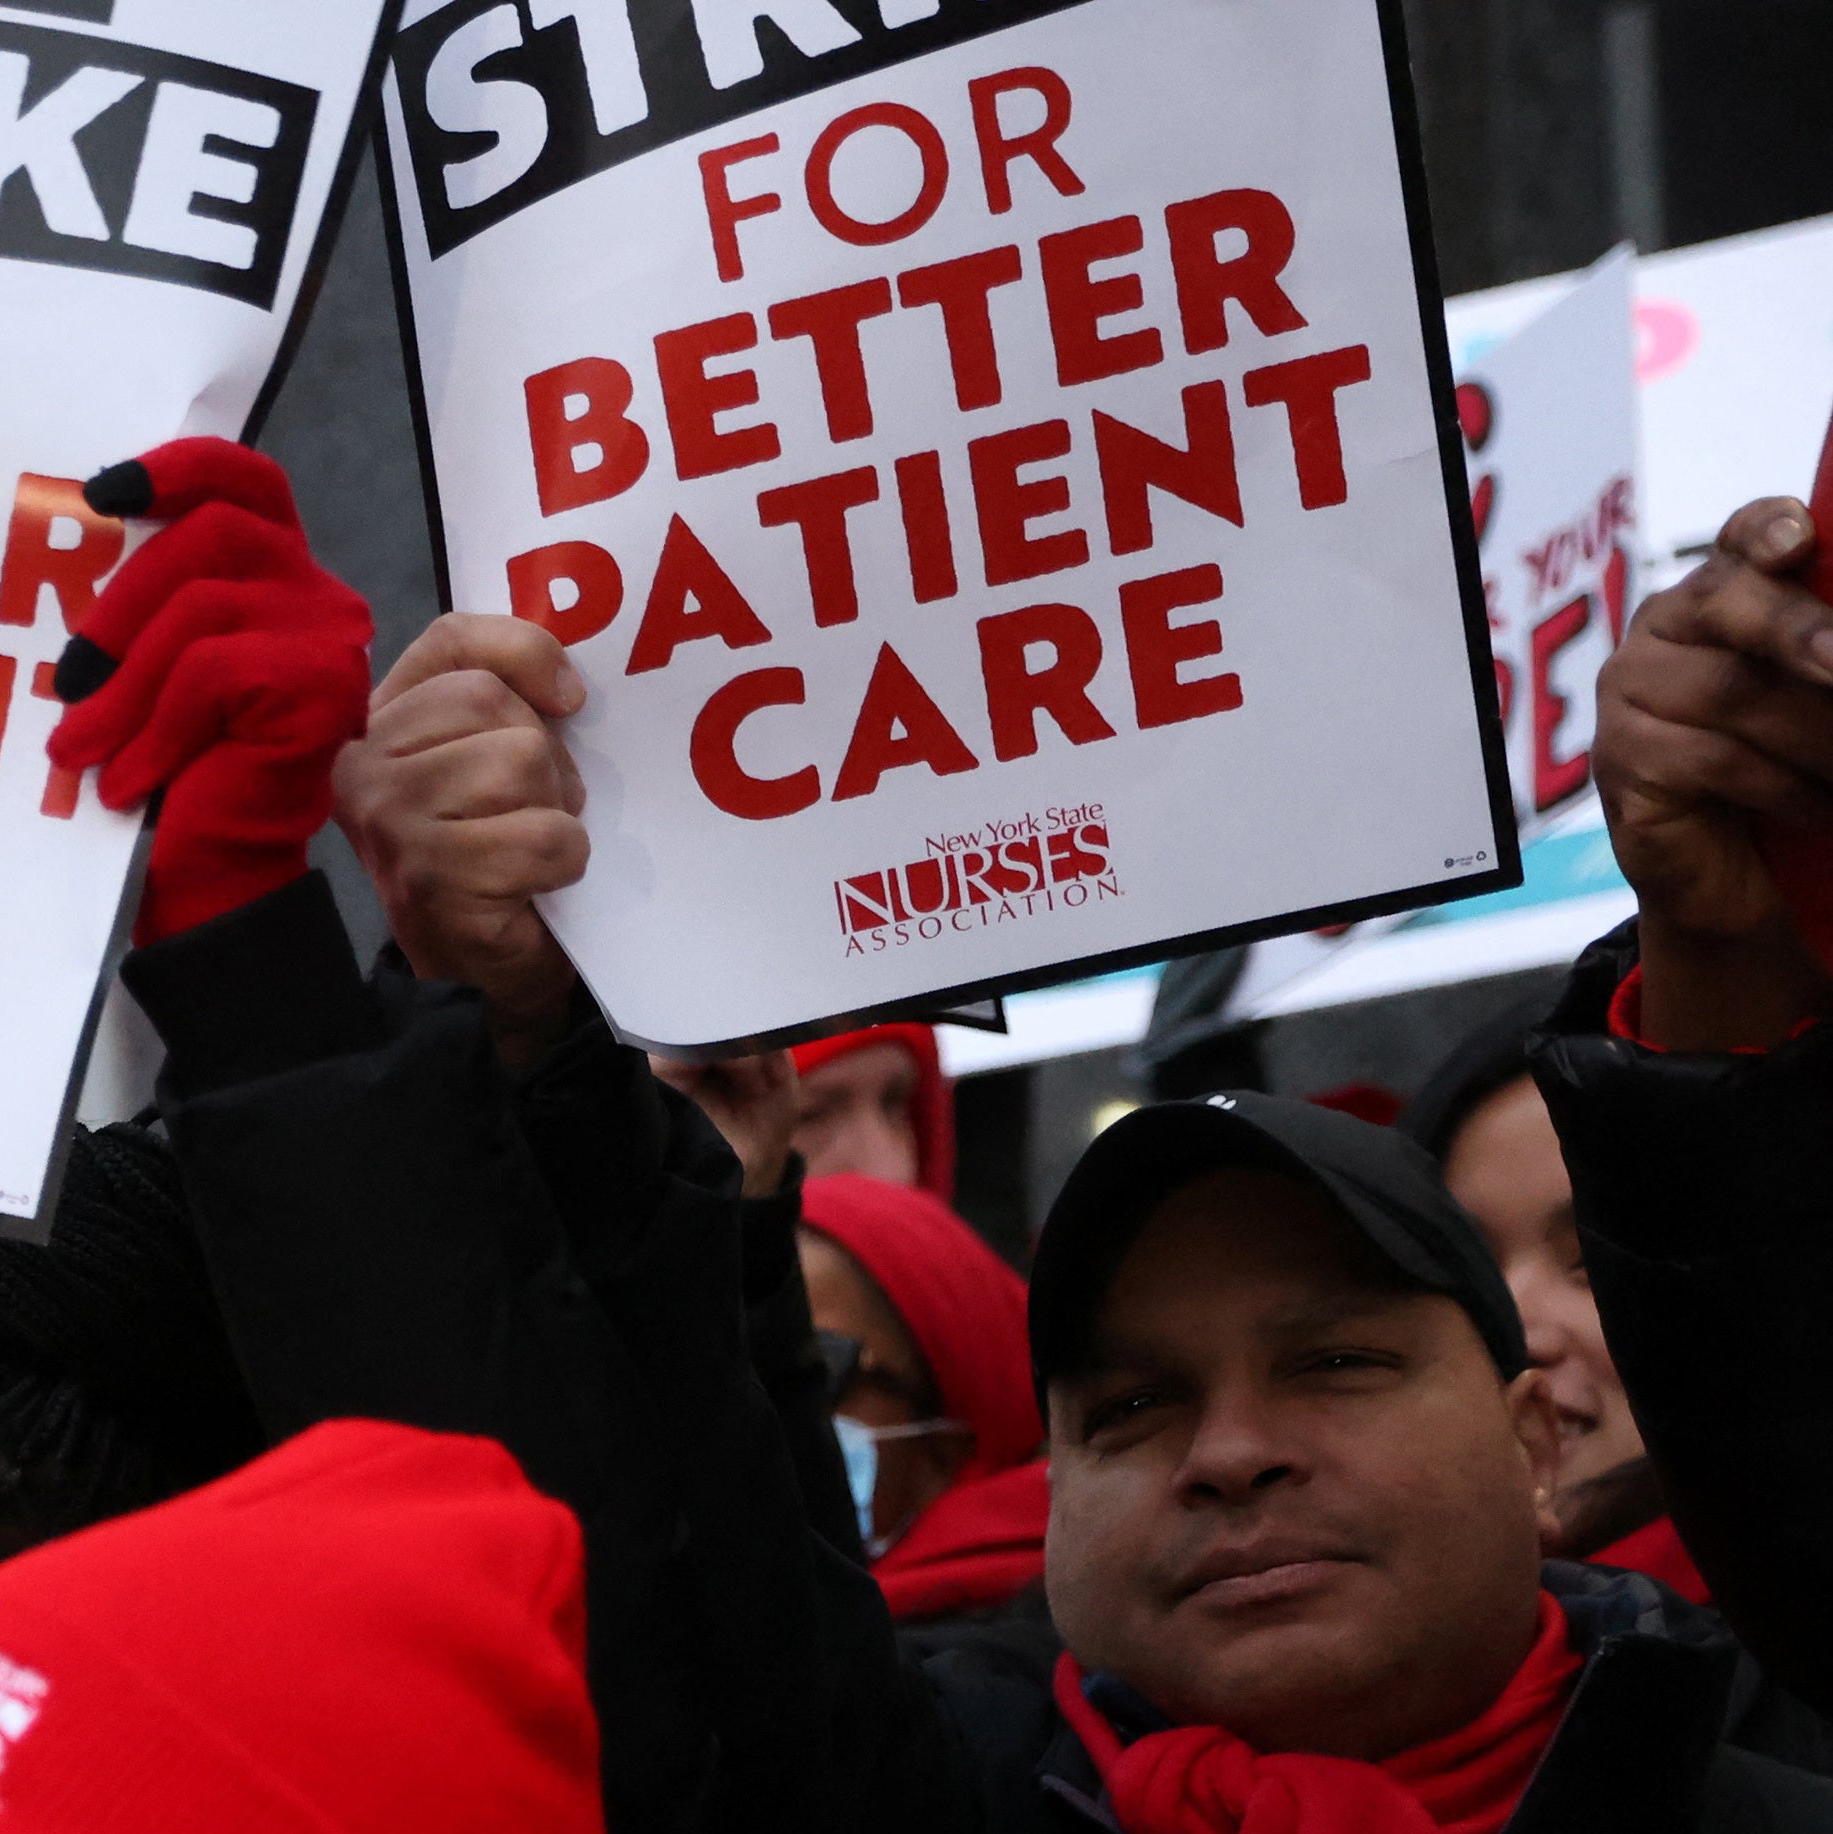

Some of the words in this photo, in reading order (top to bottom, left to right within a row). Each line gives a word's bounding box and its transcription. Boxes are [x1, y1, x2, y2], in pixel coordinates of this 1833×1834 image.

[699, 65, 1085, 284] FOR
[523, 188, 1310, 518] BETTER
[506, 342, 1370, 676] PATIENT
[689, 561, 1244, 821] CARE
[834, 819, 1115, 935] NURSES
[845, 876, 1123, 958] ASSOCIATION
[925, 830, 982, 857] New
[986, 812, 1042, 842] York
[1045, 803, 1104, 830] State
